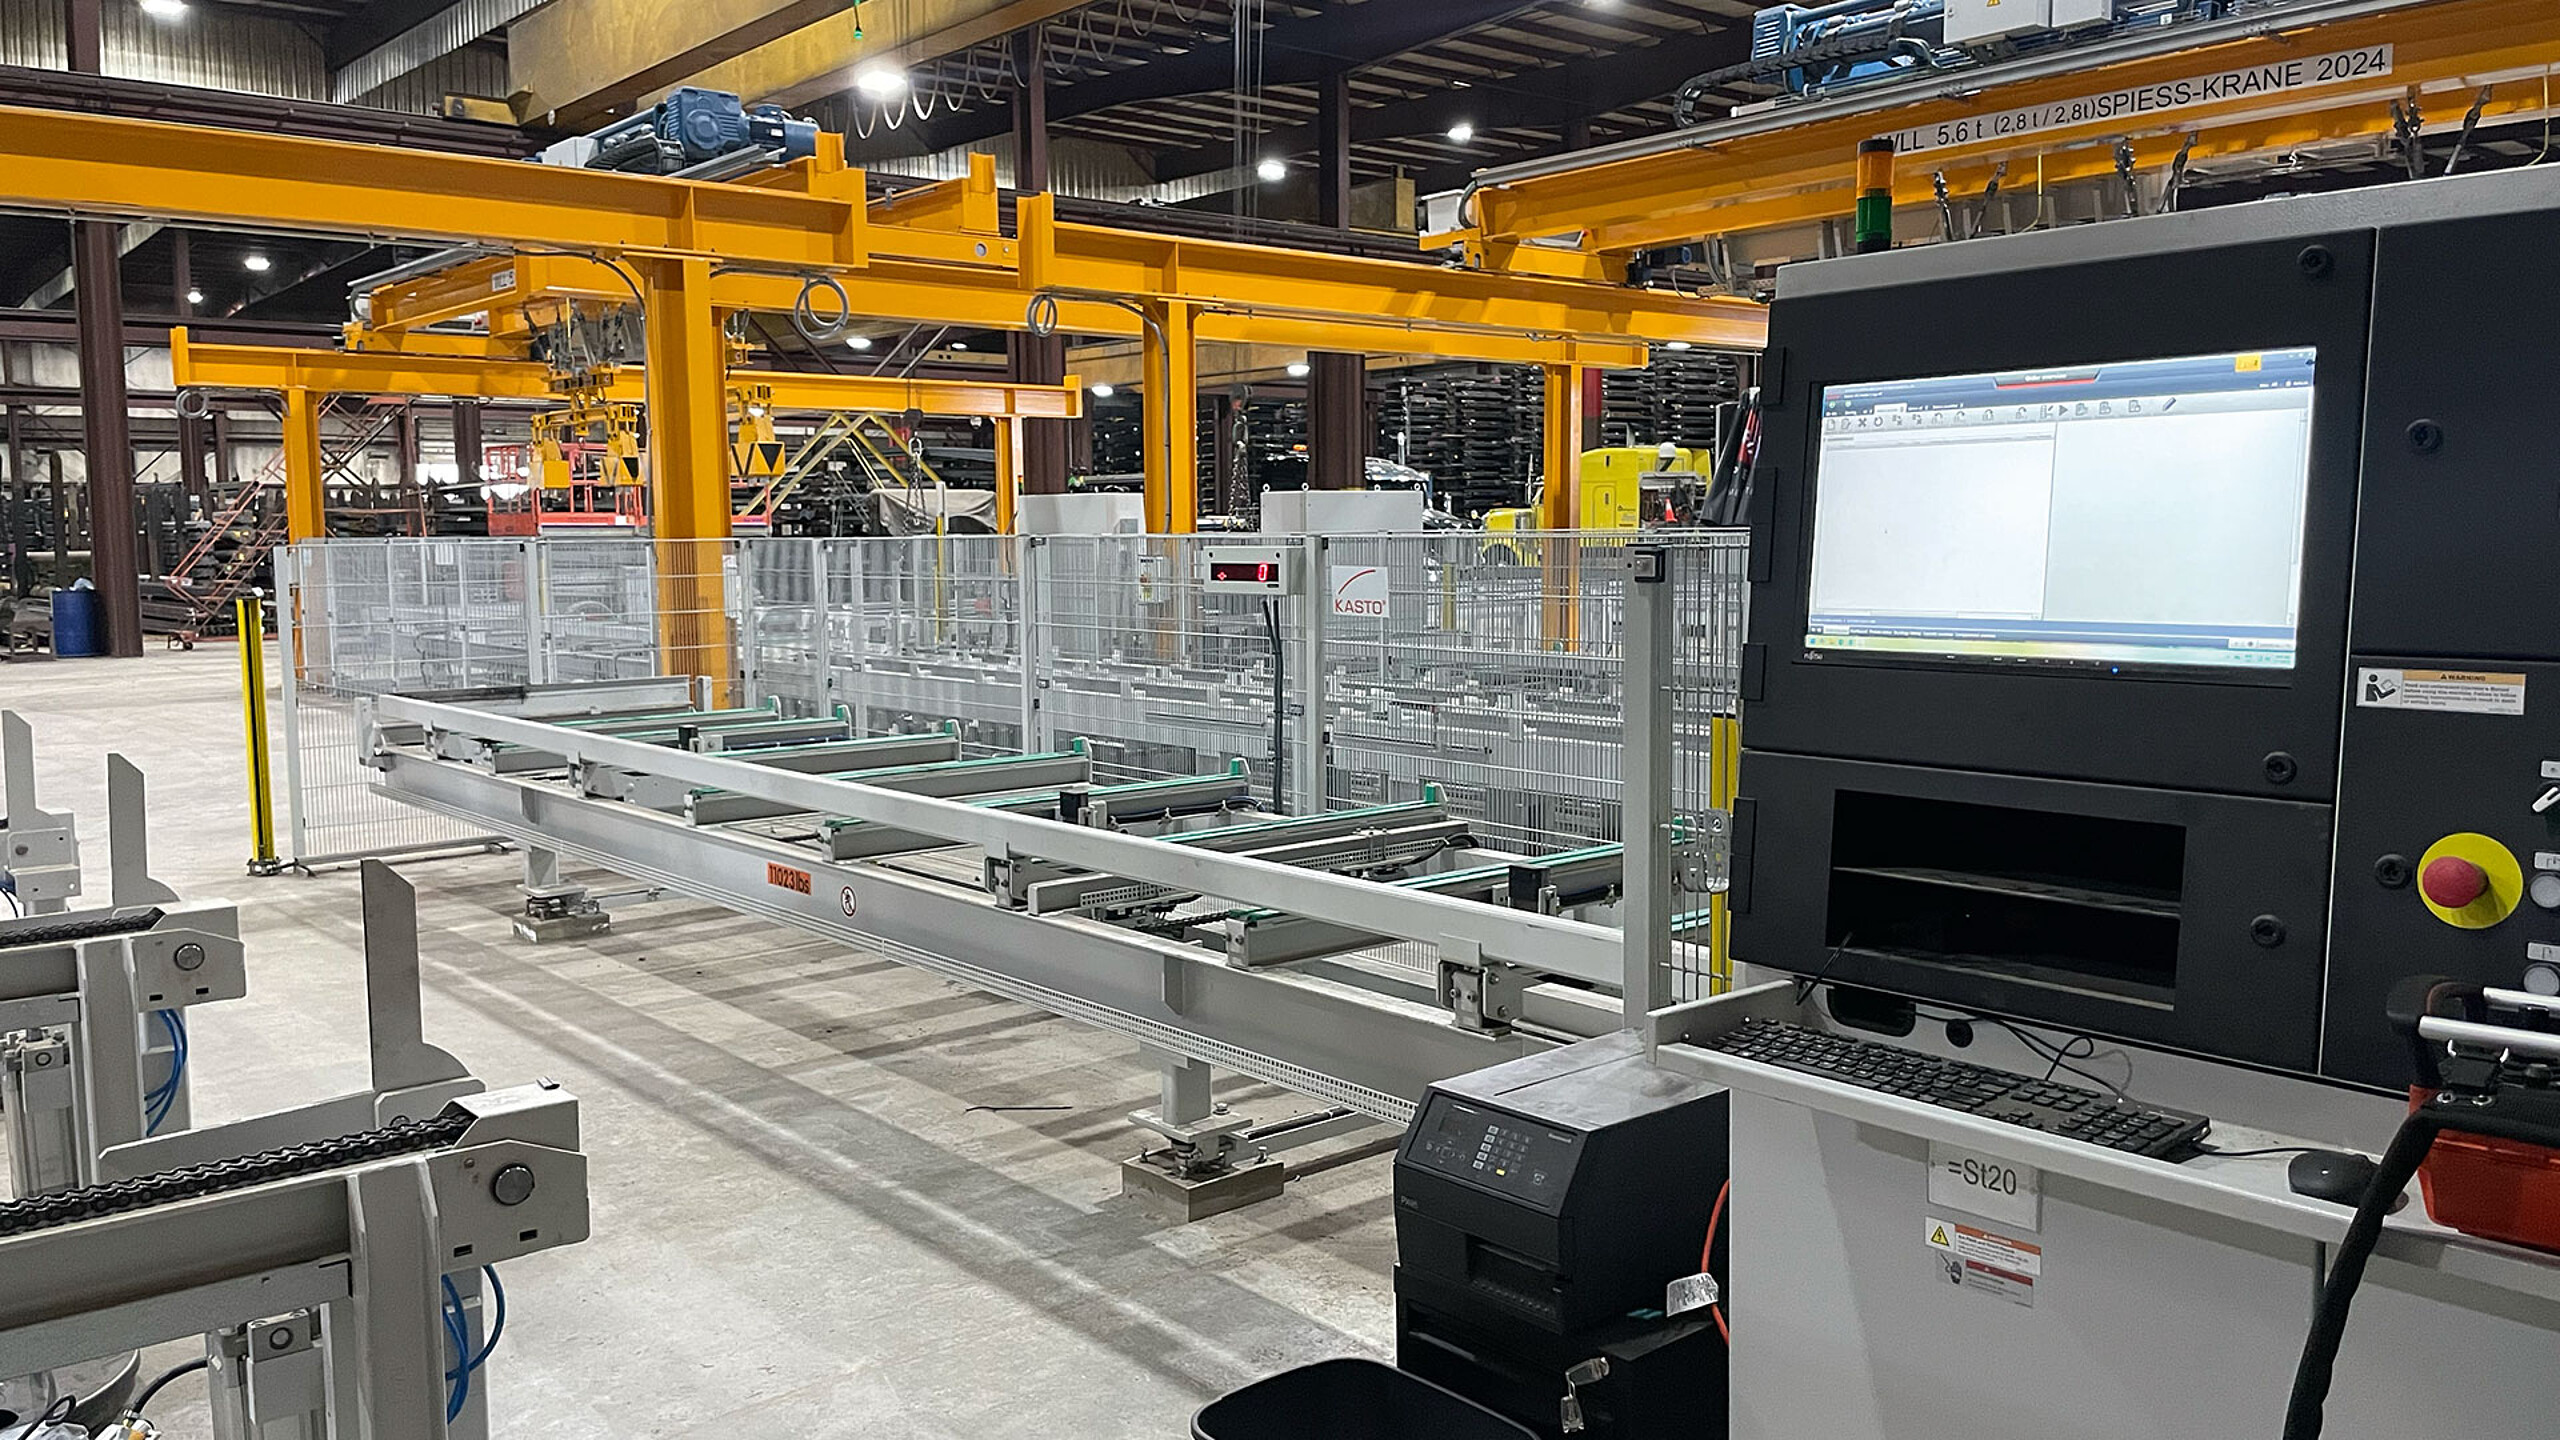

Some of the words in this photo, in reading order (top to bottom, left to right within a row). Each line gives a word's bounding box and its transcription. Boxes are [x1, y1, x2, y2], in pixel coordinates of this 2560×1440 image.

[1976, 119, 1983, 139] t
[2042, 108, 2050, 126] /
[2316, 48, 2386, 82] 2024
[1257, 563, 1268, 581] 0
[1948, 1158, 2016, 1196] =St20
